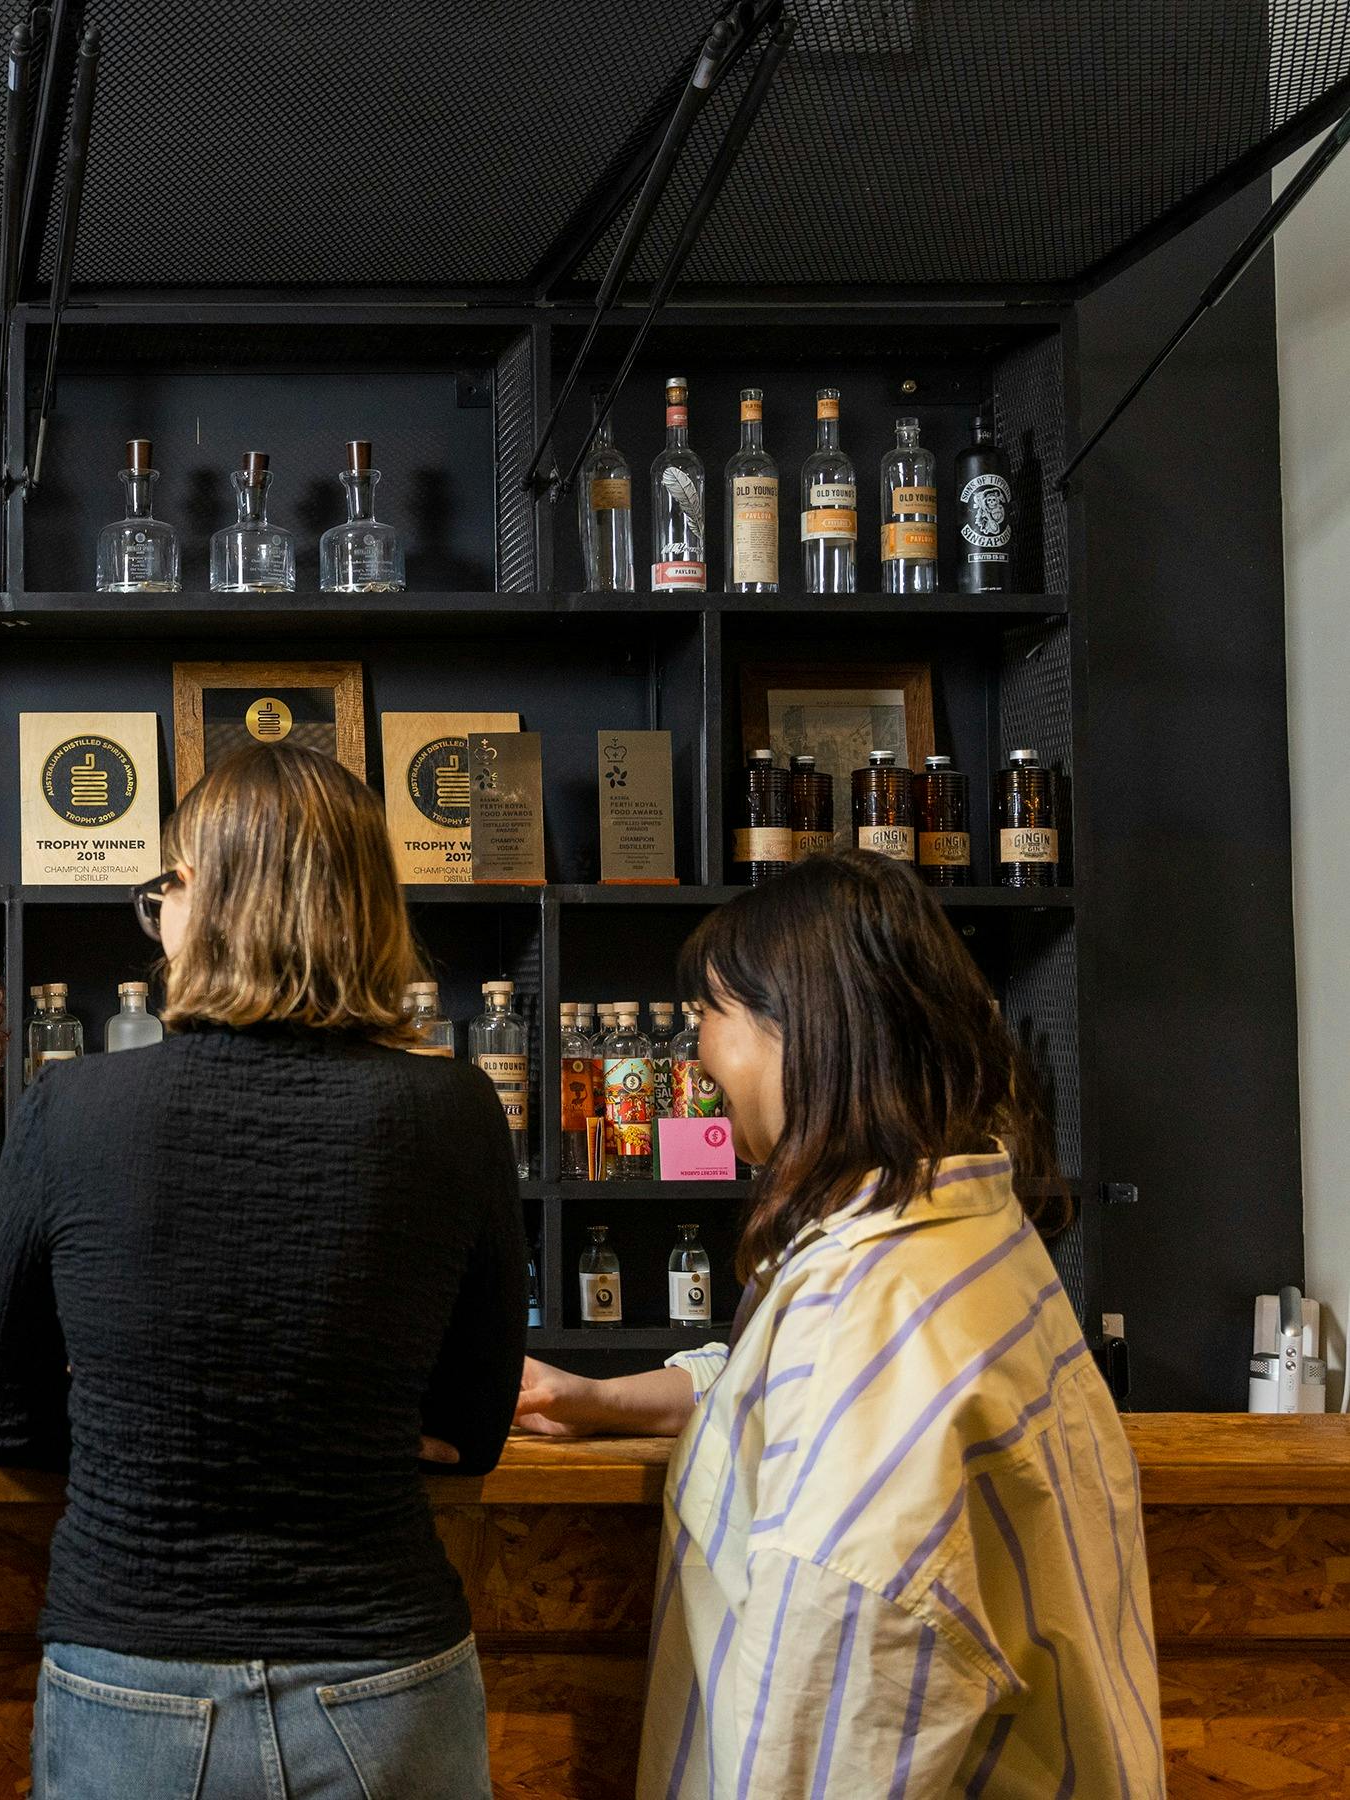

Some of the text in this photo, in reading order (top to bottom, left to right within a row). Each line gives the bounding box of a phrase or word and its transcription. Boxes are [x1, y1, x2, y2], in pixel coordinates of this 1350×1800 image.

[977, 476, 986, 485] OF
[736, 486, 750, 496] OLD
[899, 494, 913, 502] OLD
[963, 528, 1011, 546] SINGAPOR
[46, 740, 134, 797] AUSTRALIAN DISTILLED SPIRITS AWARDS
[411, 740, 464, 798] AUSTRALIAN DISTILLED
[66, 811, 116, 824] TROPHY 2018
[432, 812, 463, 824] TROPHY
[872, 830, 908, 845] GINGIN
[935, 836, 966, 850] GINGIN
[1014, 832, 1050, 848] GINGIN
[36, 840, 146, 850] TROPHY WINNER
[405, 842, 457, 851] TROPHY
[77, 852, 106, 861] 2018
[445, 853, 472, 862] 2017
[484, 1062, 497, 1070] OLD
